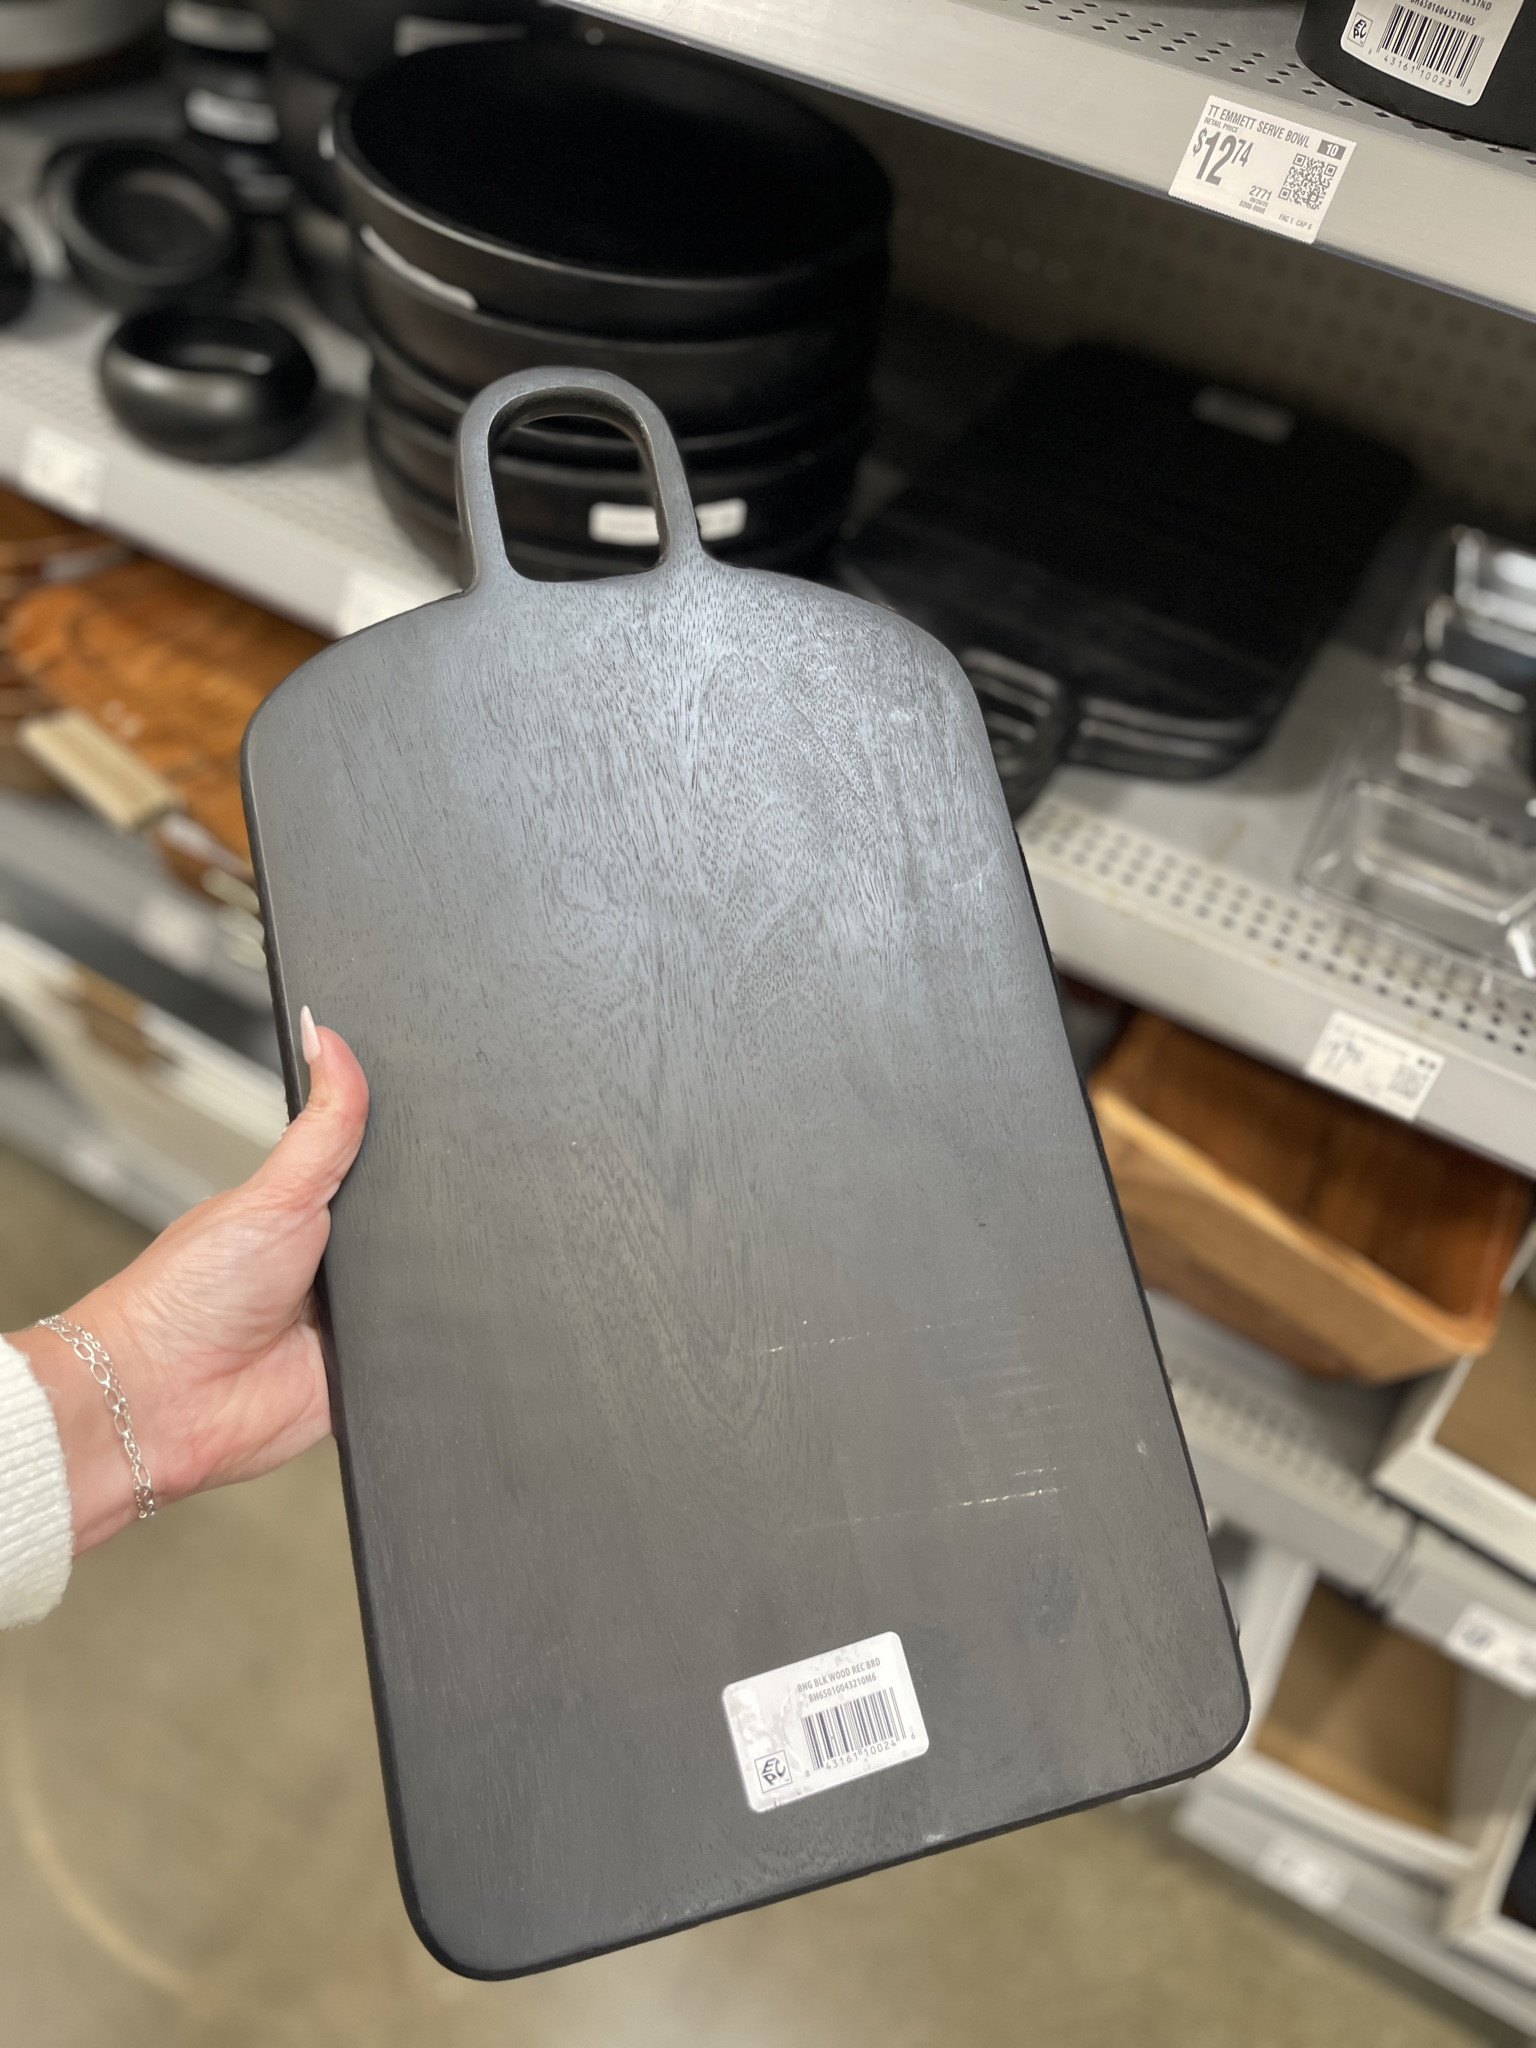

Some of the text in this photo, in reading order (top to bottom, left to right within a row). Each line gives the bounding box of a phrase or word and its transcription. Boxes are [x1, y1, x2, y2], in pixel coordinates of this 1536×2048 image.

[1204, 116, 1239, 134] RETAIL PRICE
[1208, 104, 1340, 157] TT EMMETT SERVE BOWL 10
[797, 1657, 881, 1693] BHG BLK WOOD REC BRD
[825, 1752, 858, 1770] 43161
[864, 1740, 897, 1757] 10024
